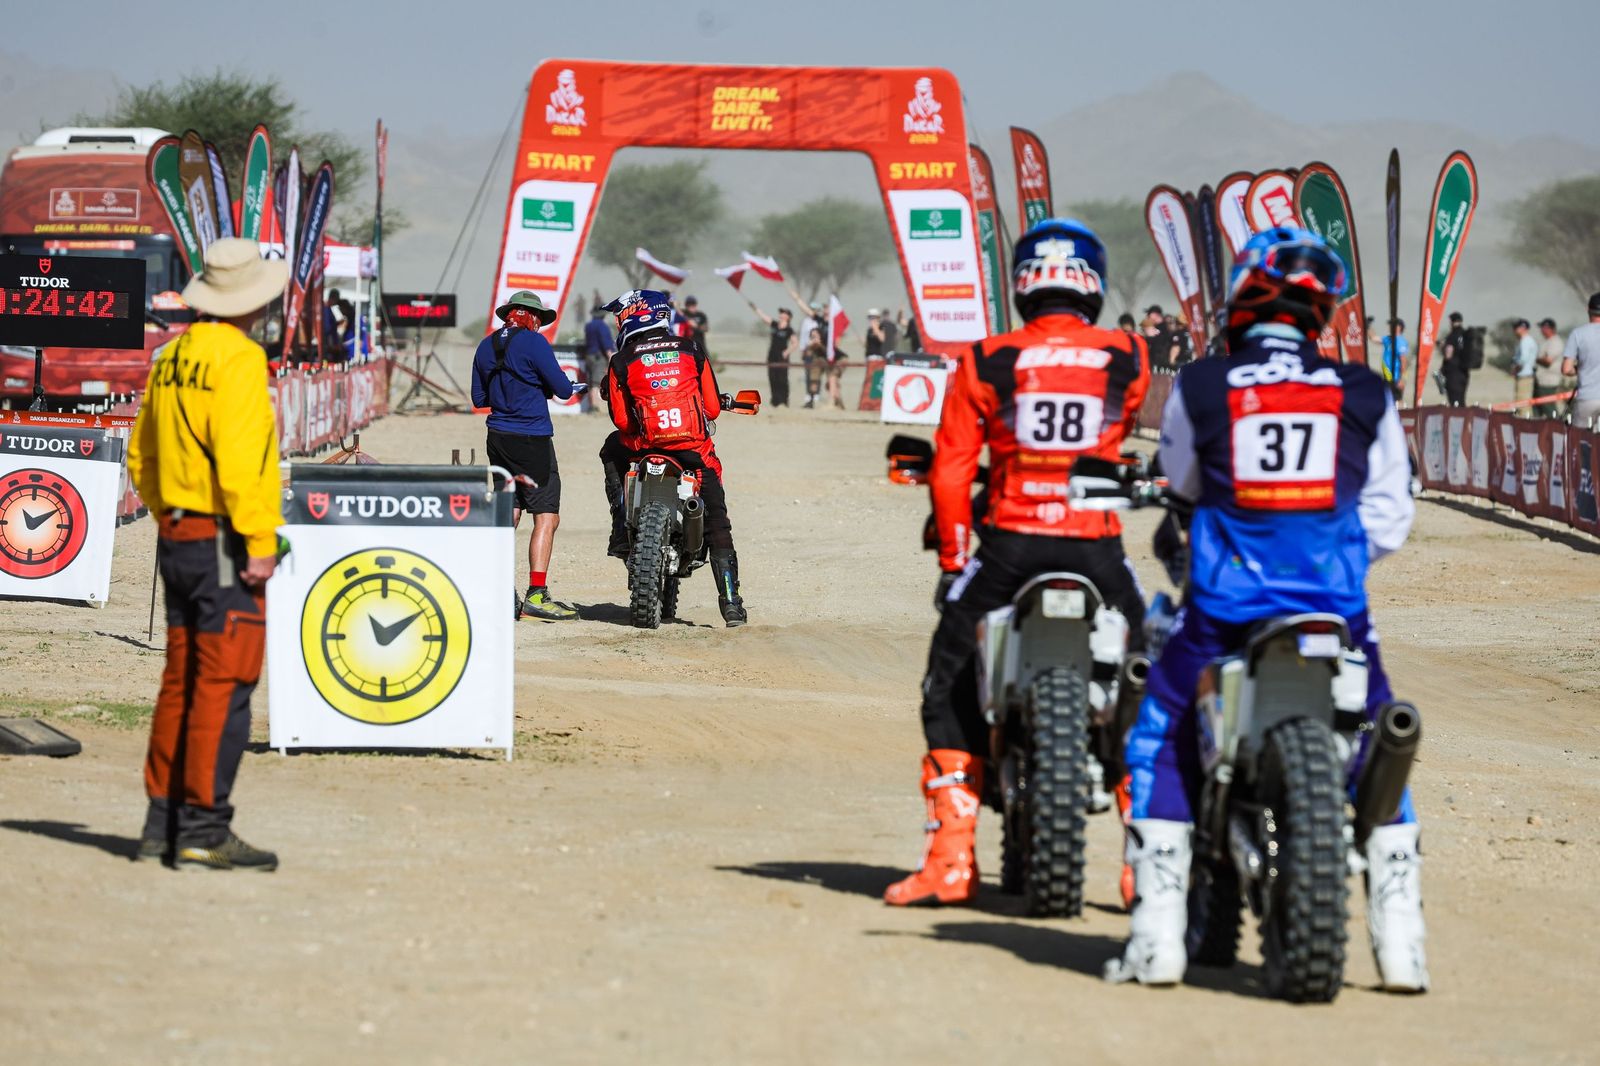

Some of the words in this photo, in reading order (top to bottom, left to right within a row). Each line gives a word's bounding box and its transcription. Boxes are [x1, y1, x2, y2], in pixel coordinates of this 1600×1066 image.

[713, 87, 780, 102] DREAM.
[712, 101, 764, 115] DARE.
[711, 115, 751, 131] LIVE
[751, 116, 773, 131] IT.
[527, 152, 596, 172] START
[889, 162, 957, 179] START
[20, 276, 70, 288] TUDOR
[655, 351, 680, 359] KING
[48, 416, 85, 424] ORGANIZATION
[657, 408, 682, 429] 39
[1033, 401, 1085, 442] 38
[7, 435, 75, 453] TUDOR
[1260, 423, 1313, 472] 37
[335, 495, 443, 518] TUDOR
